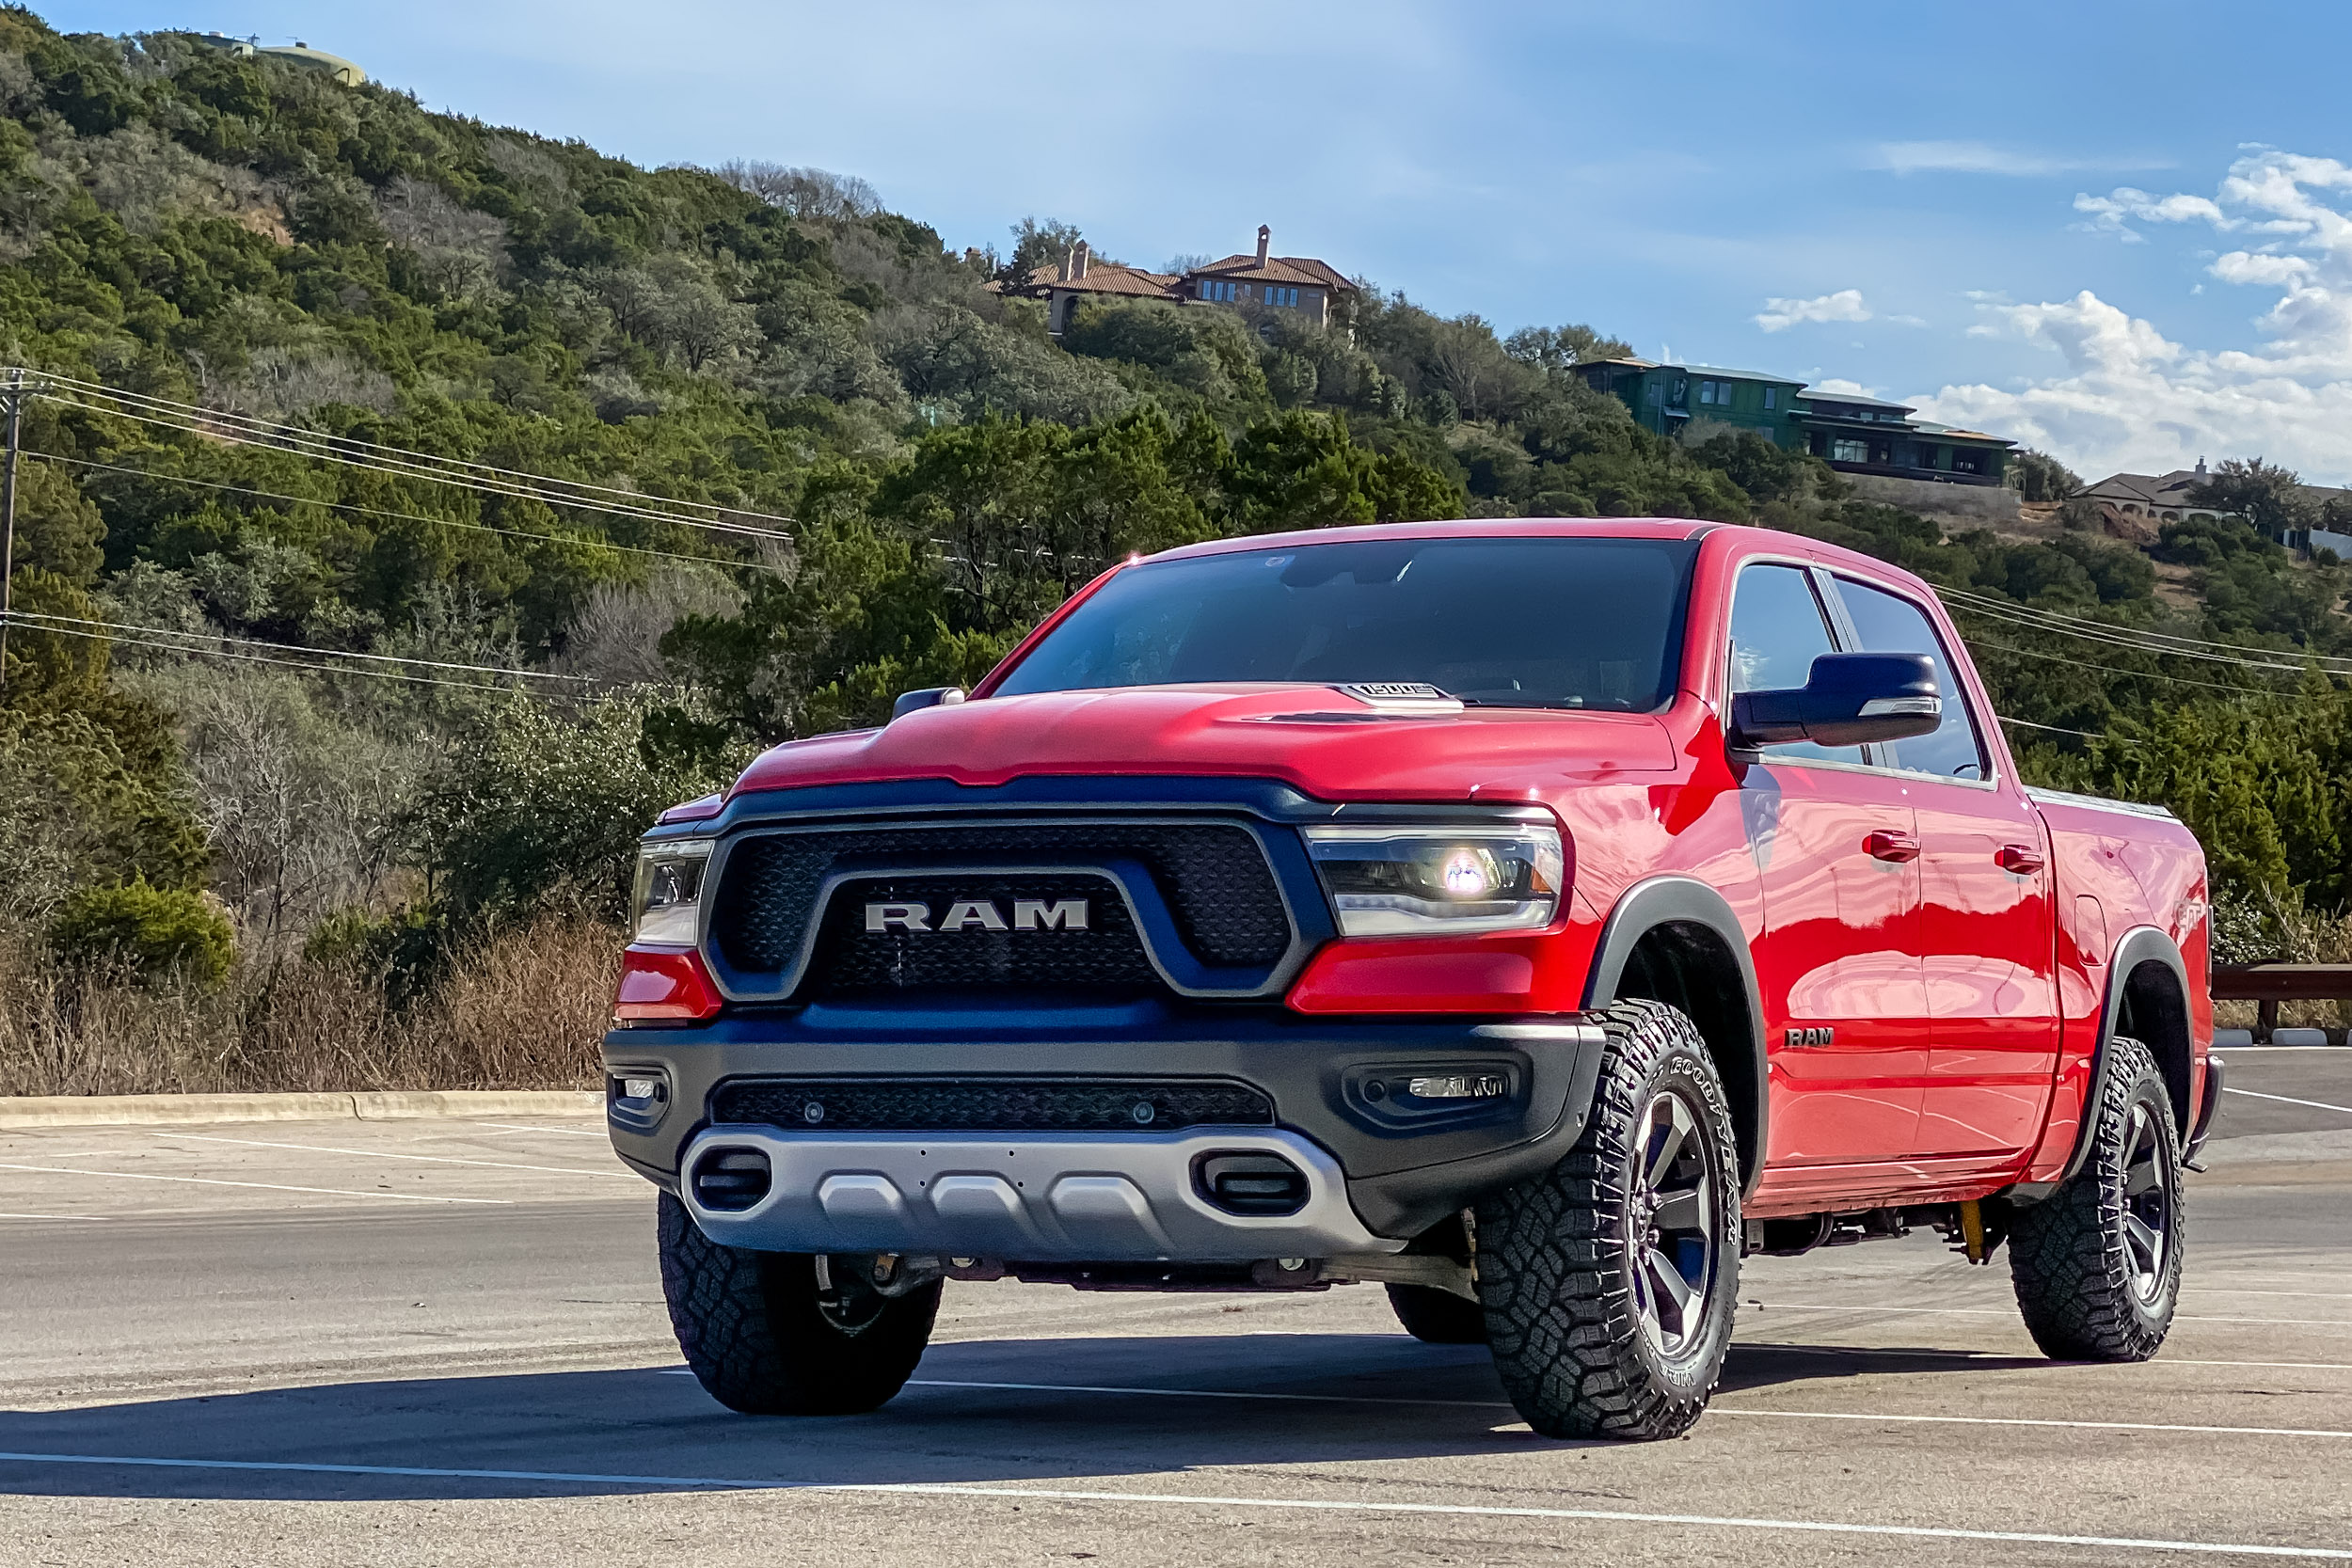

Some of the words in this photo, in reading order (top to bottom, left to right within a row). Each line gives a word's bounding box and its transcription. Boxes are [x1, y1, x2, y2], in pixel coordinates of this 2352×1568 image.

[1359, 683, 1417, 695] 1500
[865, 899, 1089, 931] RAM
[1785, 1027, 1834, 1046] RAM
[1670, 1056, 1737, 1245] GOODYEAR
